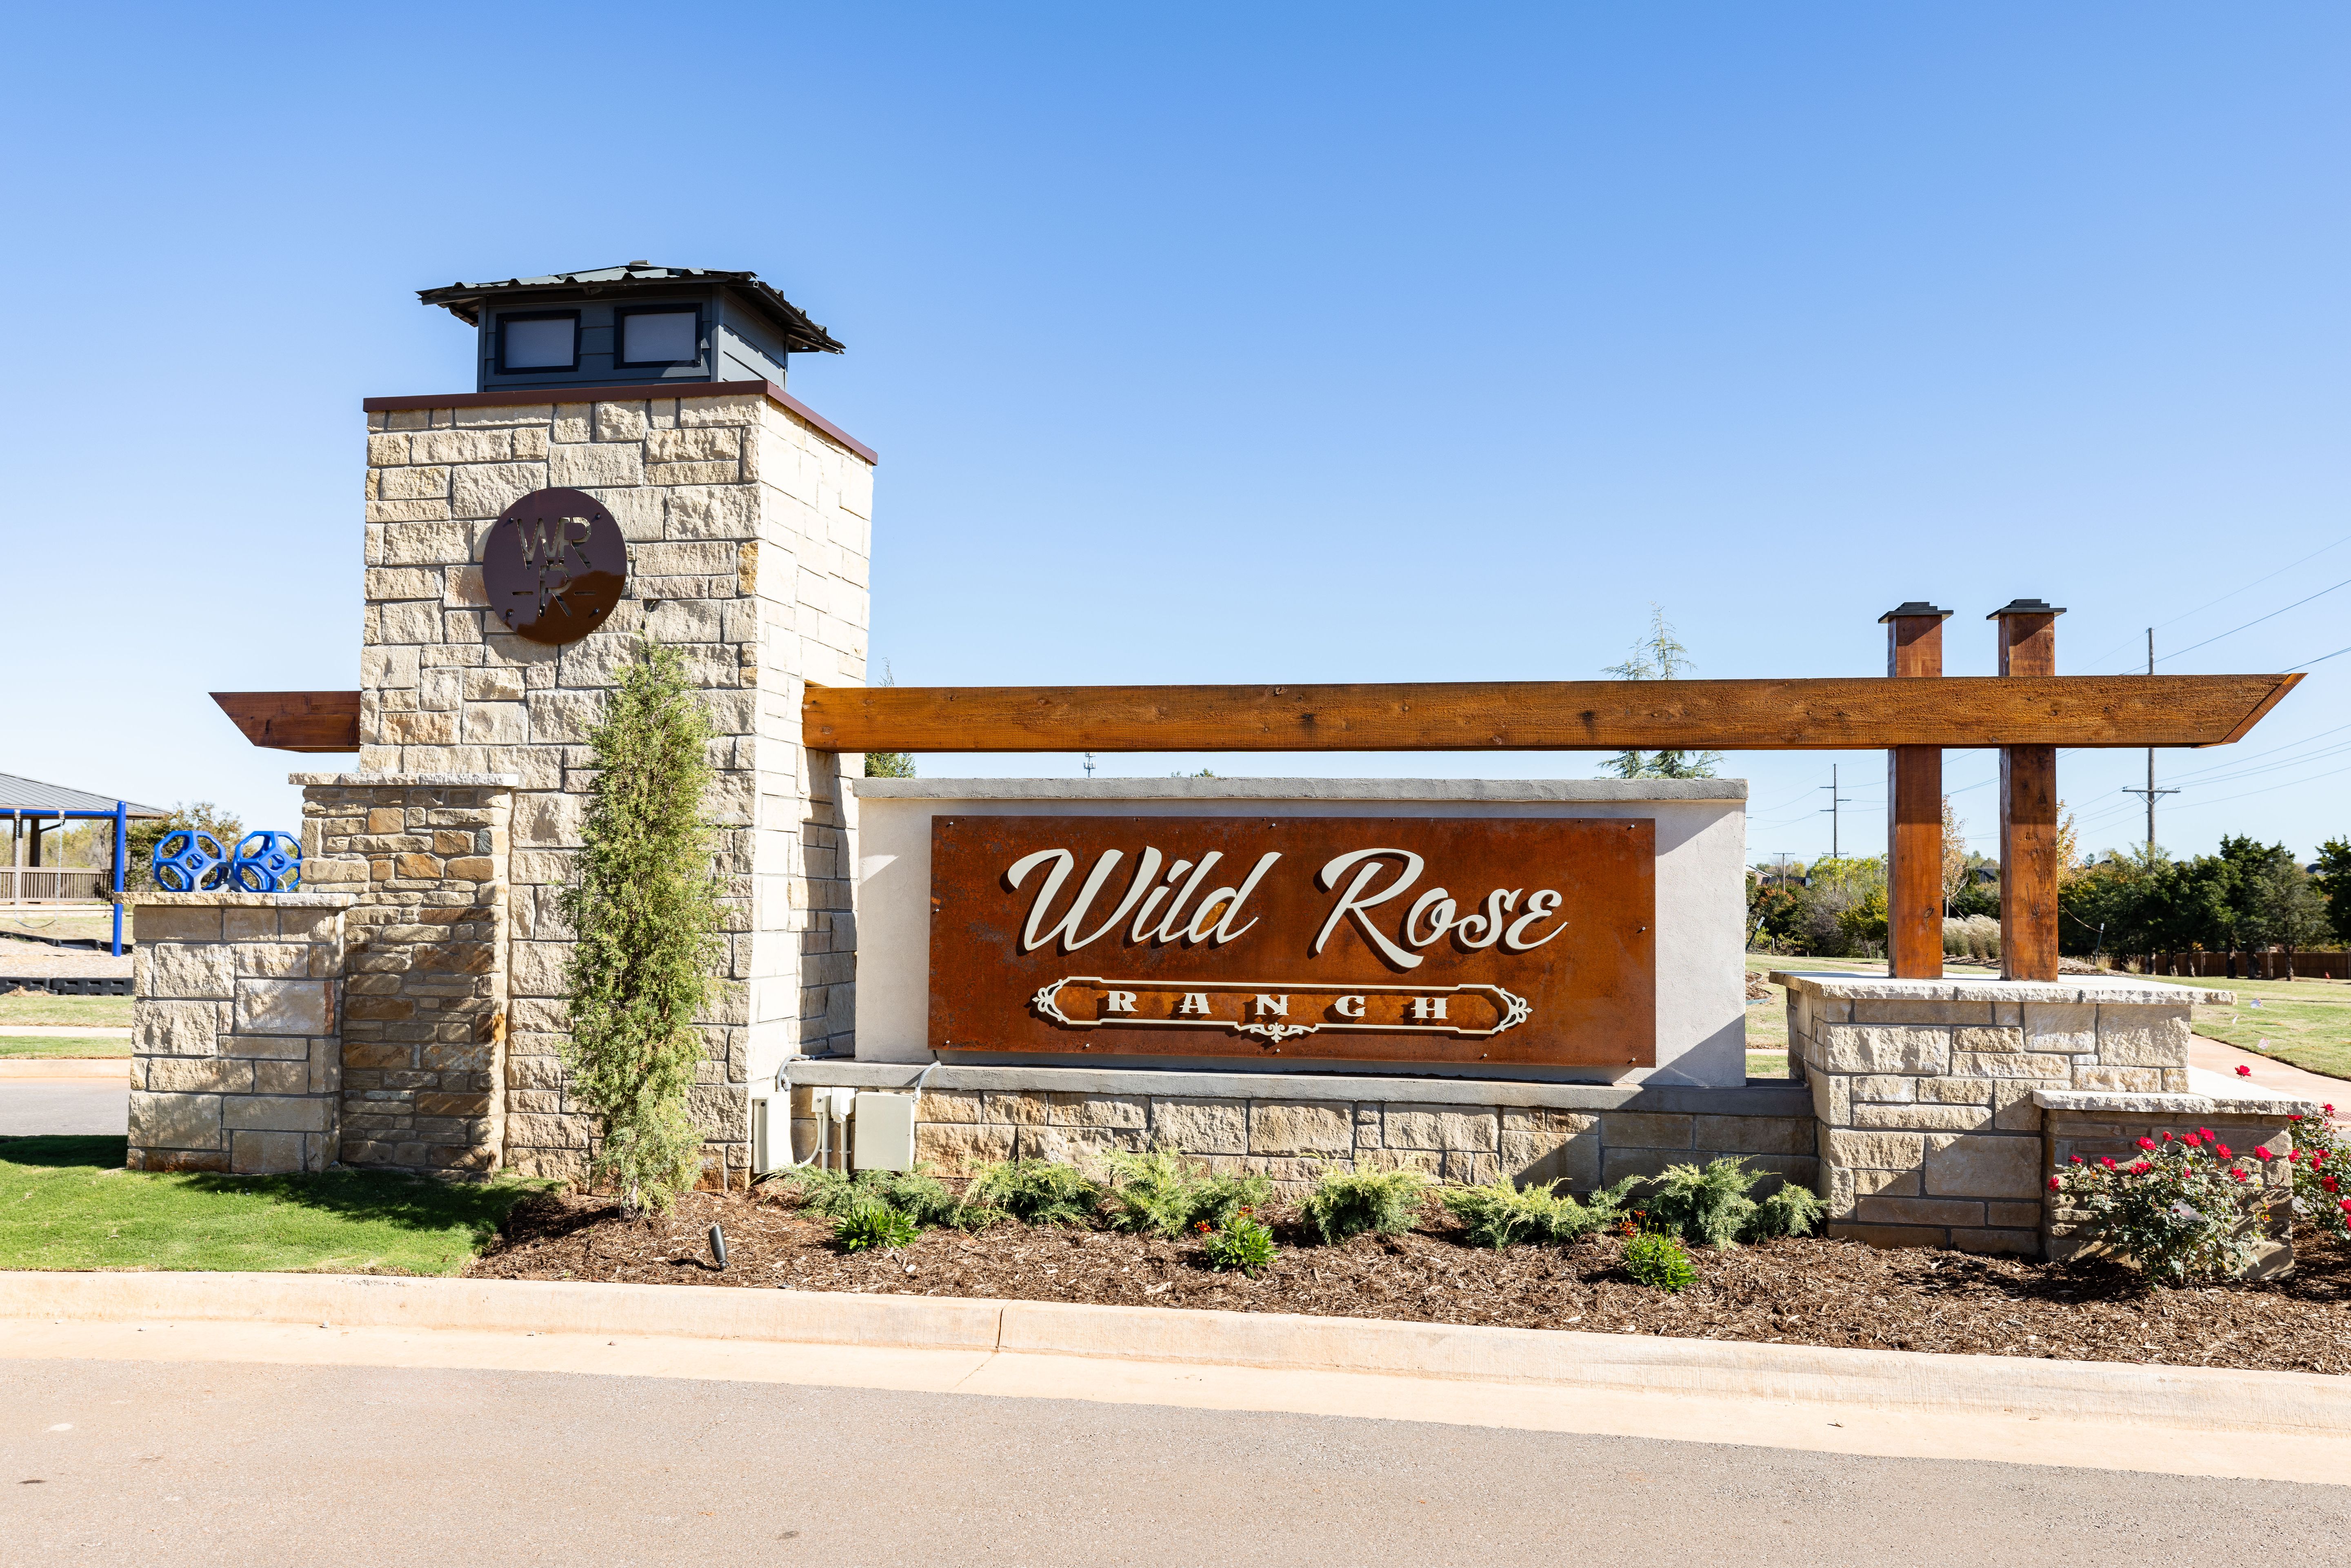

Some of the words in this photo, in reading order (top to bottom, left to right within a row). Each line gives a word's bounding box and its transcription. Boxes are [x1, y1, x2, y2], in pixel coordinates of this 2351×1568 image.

[517, 517, 591, 570] WR
[1007, 846, 1282, 951] Wild
[1315, 848, 1569, 968] Rose
[1107, 991, 1449, 1019] RANCH
